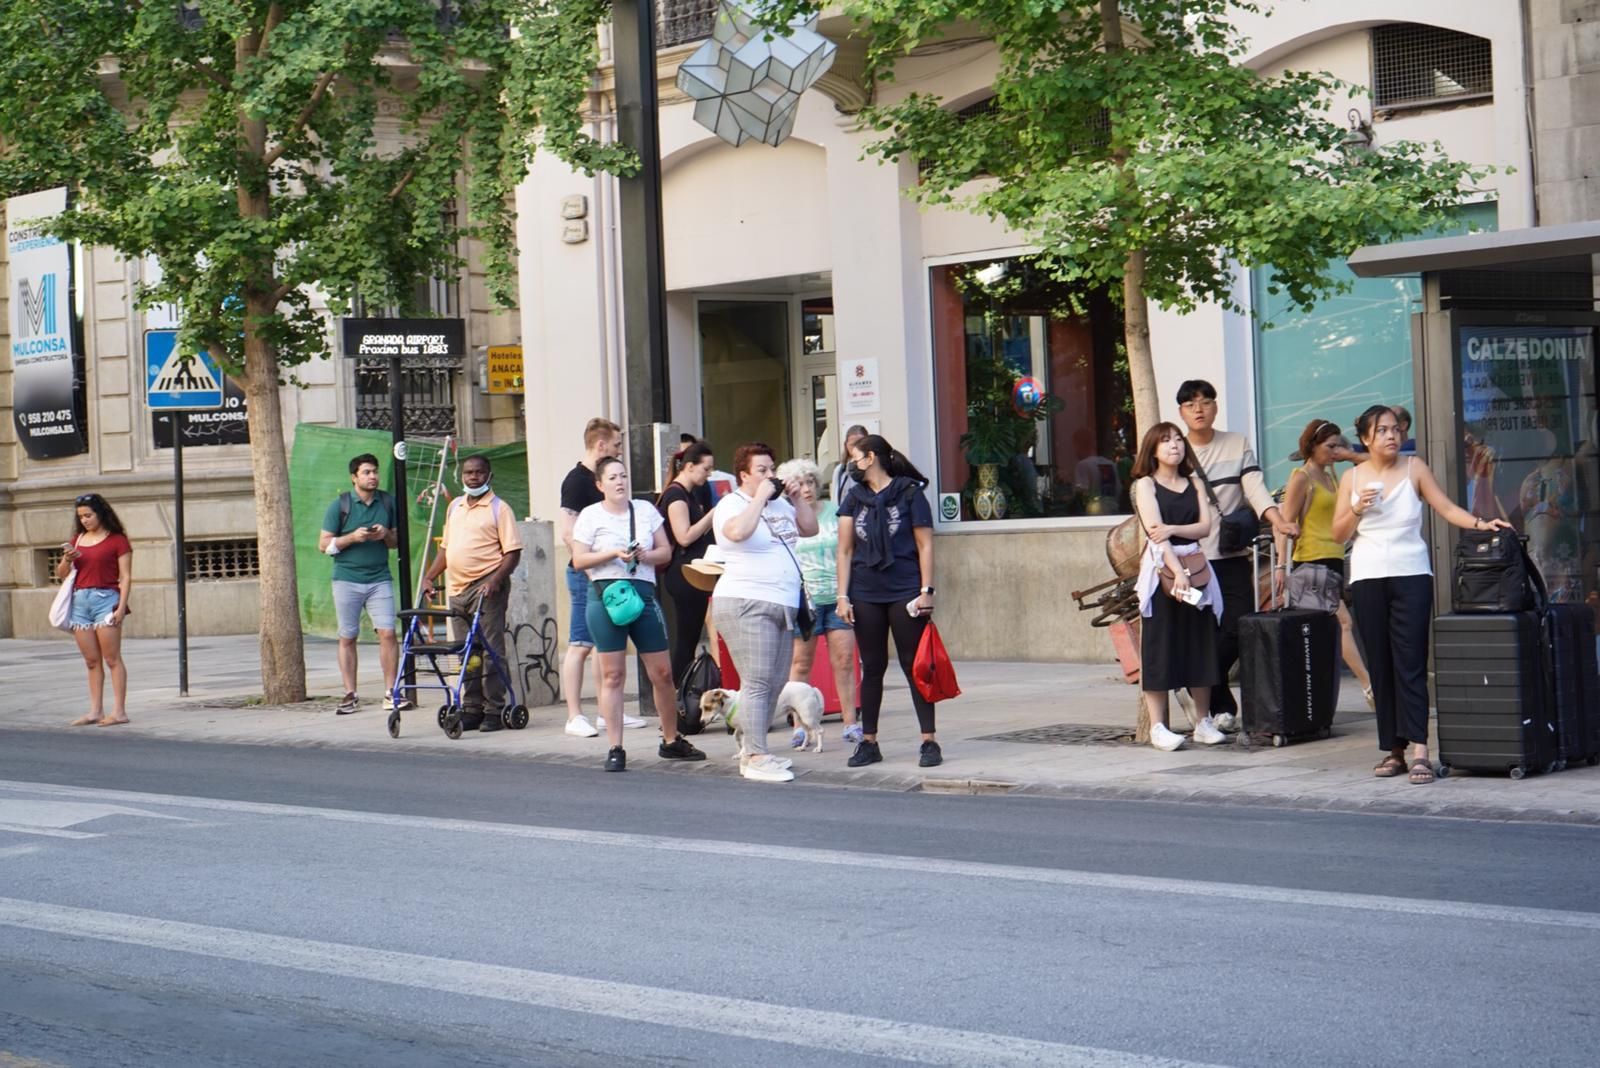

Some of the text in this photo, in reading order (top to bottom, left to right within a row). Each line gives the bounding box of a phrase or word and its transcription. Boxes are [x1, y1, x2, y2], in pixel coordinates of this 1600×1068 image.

[363, 335, 445, 344] GRANADA AIRPORT
[13, 337, 66, 356] MULCONSA
[401, 344, 419, 354] bus
[1467, 337, 1586, 361] CALZEDONIA
[491, 352, 522, 360] Hoteles
[42, 411, 55, 422] 210
[56, 409, 71, 420] 475
